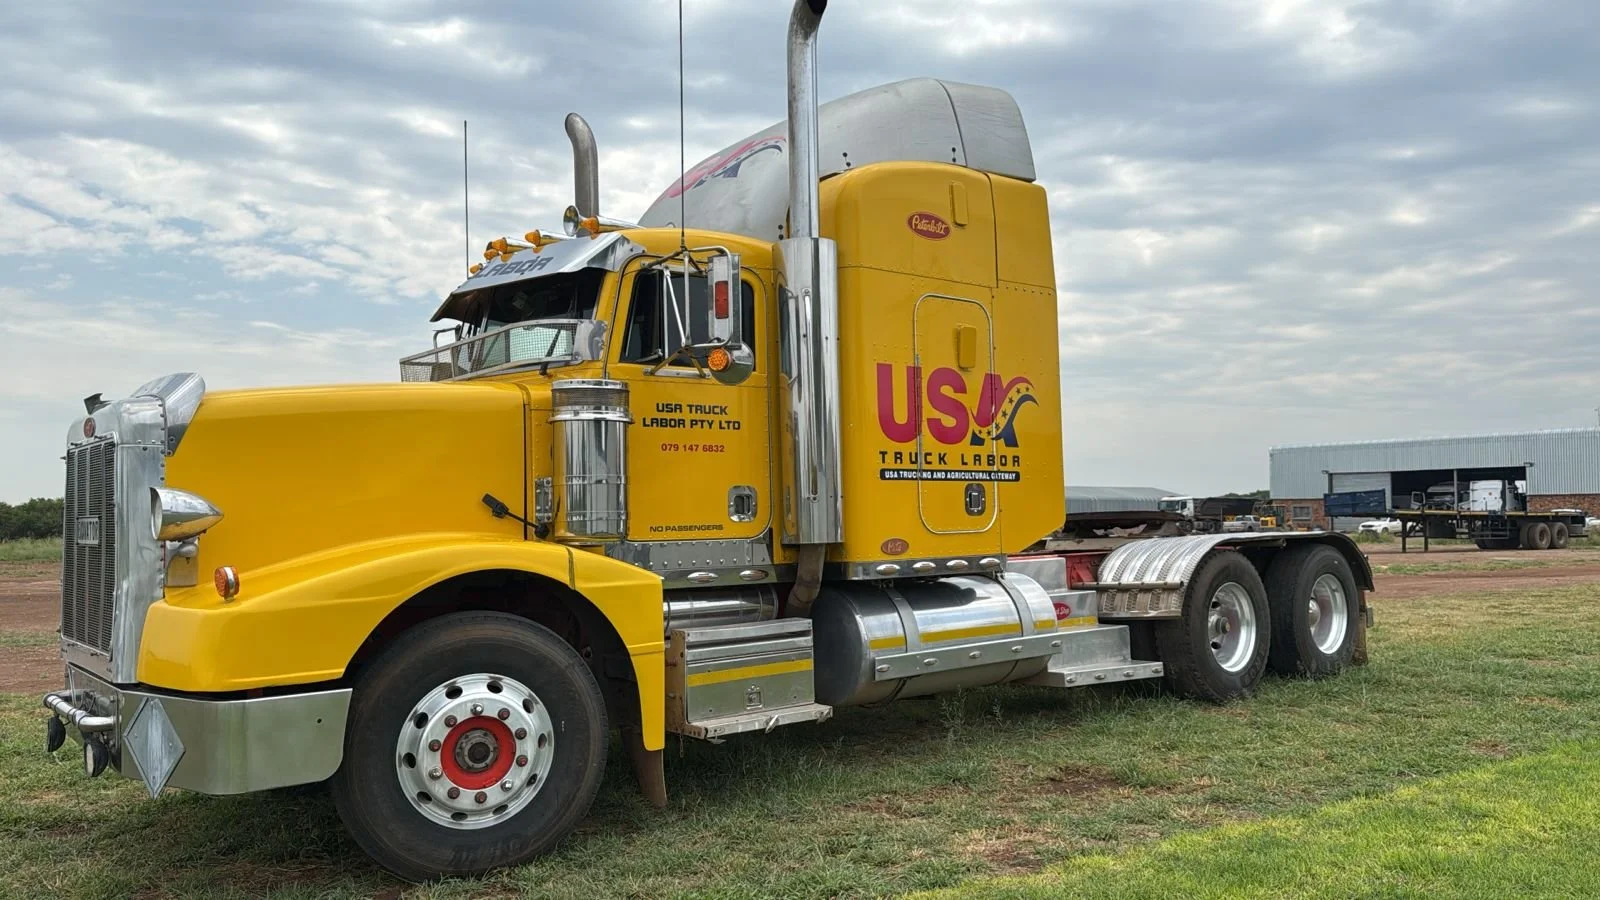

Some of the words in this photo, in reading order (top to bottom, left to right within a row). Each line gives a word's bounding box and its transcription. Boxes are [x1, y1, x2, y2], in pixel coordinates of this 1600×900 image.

[656, 402, 683, 413] USA
[687, 404, 728, 415] TRUCK
[876, 363, 1040, 448] USA
[642, 418, 686, 429] LABOR
[690, 420, 714, 430] PTY
[719, 421, 741, 431] LTD
[661, 443, 679, 452] 079
[683, 444, 699, 452] 147
[702, 445, 725, 453] 6832
[879, 451, 947, 465] TRUCK
[961, 454, 1020, 468] LABOR
[884, 471, 898, 479] USA
[900, 471, 932, 479] TRUCNG
[933, 471, 946, 479] AND
[947, 472, 990, 480] AGRICULTURAL
[665, 524, 724, 532] PASSENGERS
